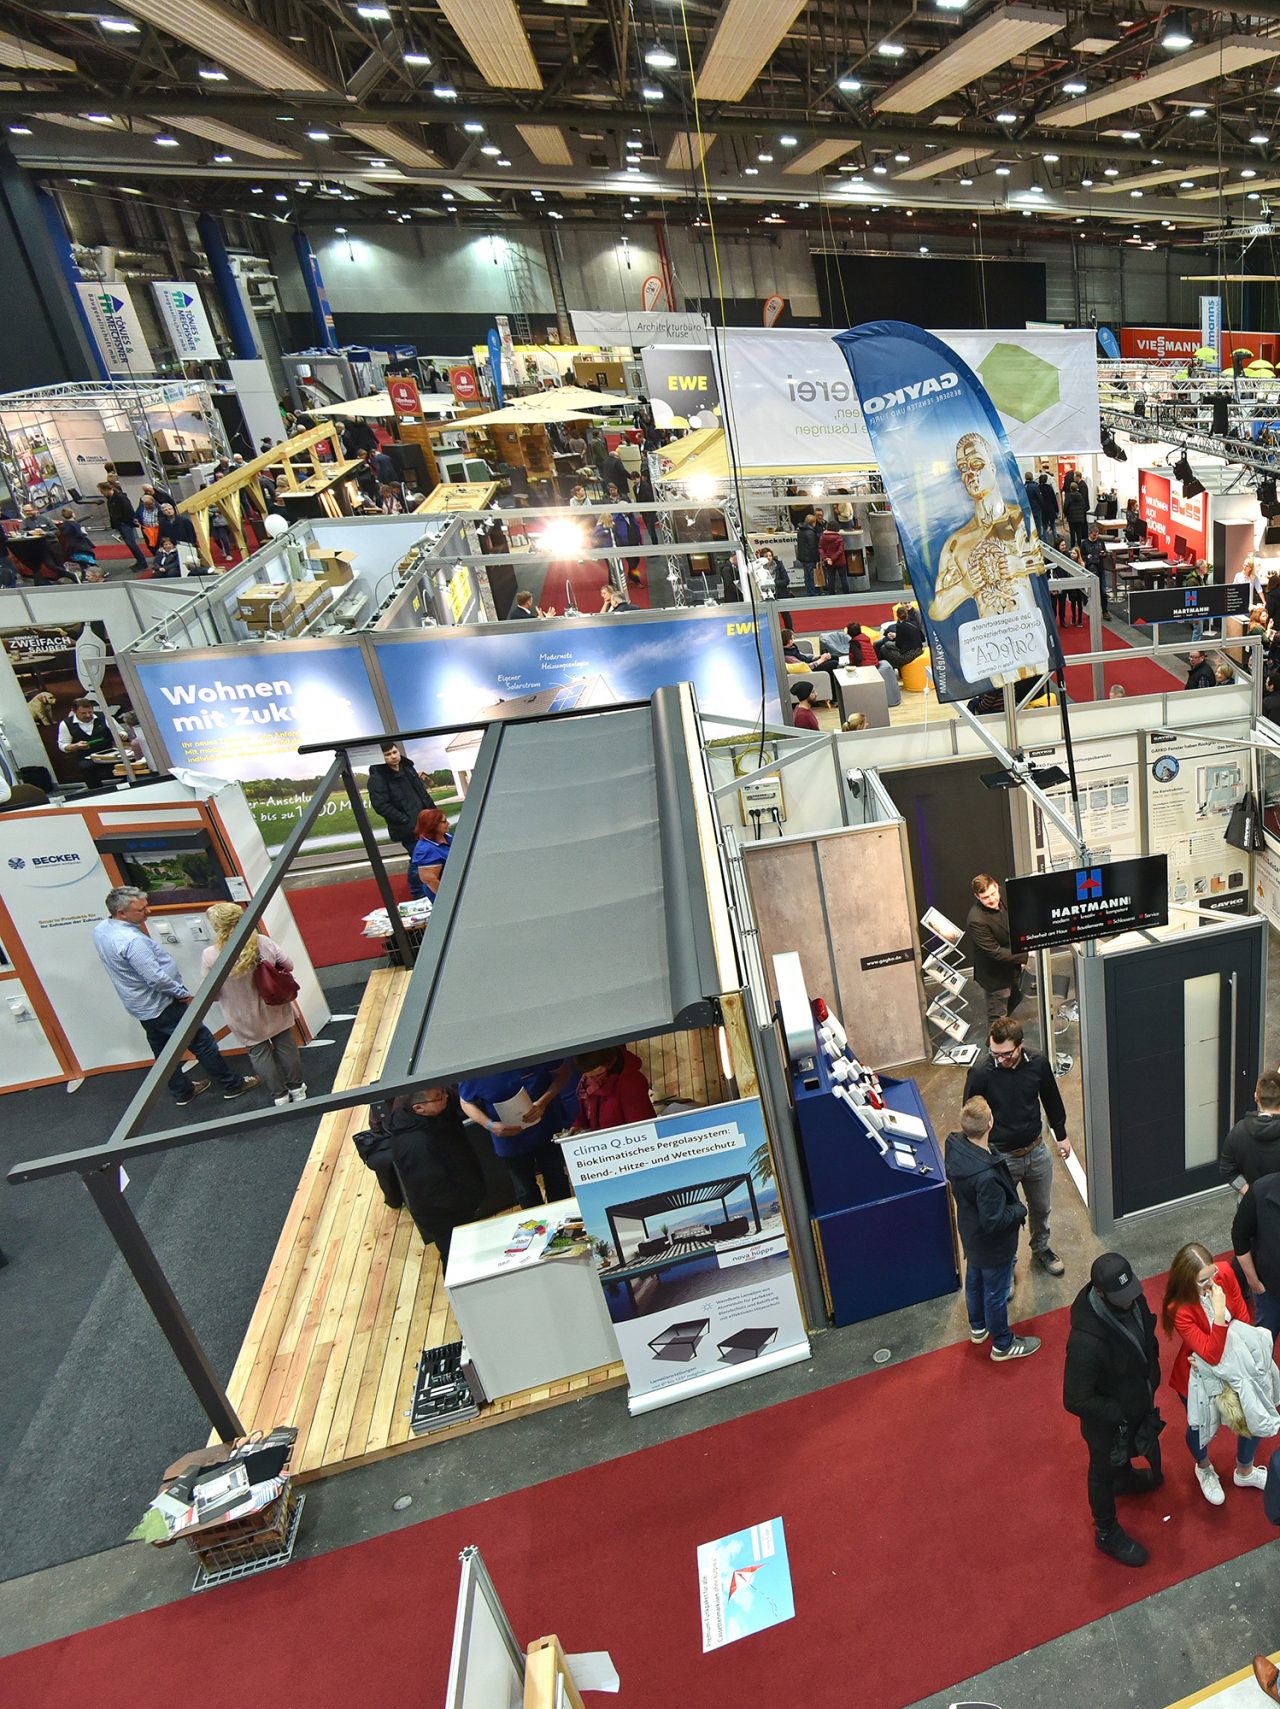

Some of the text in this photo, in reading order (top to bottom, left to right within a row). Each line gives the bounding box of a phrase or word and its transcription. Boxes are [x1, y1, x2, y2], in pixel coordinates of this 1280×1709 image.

[114, 316, 131, 346] TÖNJES
[178, 310, 196, 351] MEICHSNER
[637, 320, 702, 333] Architekturbüro
[666, 326, 689, 338] Kruse
[105, 316, 128, 364] MEICHSNER
[1137, 335, 1201, 357] VIESSMANN
[668, 376, 708, 391] EWE
[726, 622, 760, 637] EWE
[8, 636, 72, 650] ZWEIFACH
[28, 644, 68, 654] SAUBER
[539, 653, 573, 661] Modernste
[497, 674, 522, 683] Eigener
[506, 682, 541, 690] Solarstrom
[160, 679, 293, 706] Wohnen
[172, 708, 224, 733] mit
[260, 812, 295, 822] bis zu
[32, 853, 80, 866] BECKER
[1051, 896, 1129, 918] HARTMANN
[1106, 906, 1129, 915] kompetent
[1026, 932, 1048, 941] Sicherheit
[1076, 922, 1104, 931] Bauelemente
[1112, 916, 1136, 924] Schlosserei
[573, 1133, 648, 1157] clima Q.bus
[576, 1128, 732, 1169] Bioklimatisches Pergolasystem:
[580, 1139, 736, 1182] Blend-, Hitze- und Wetterschutz
[751, 1246, 774, 1256] hüppe
